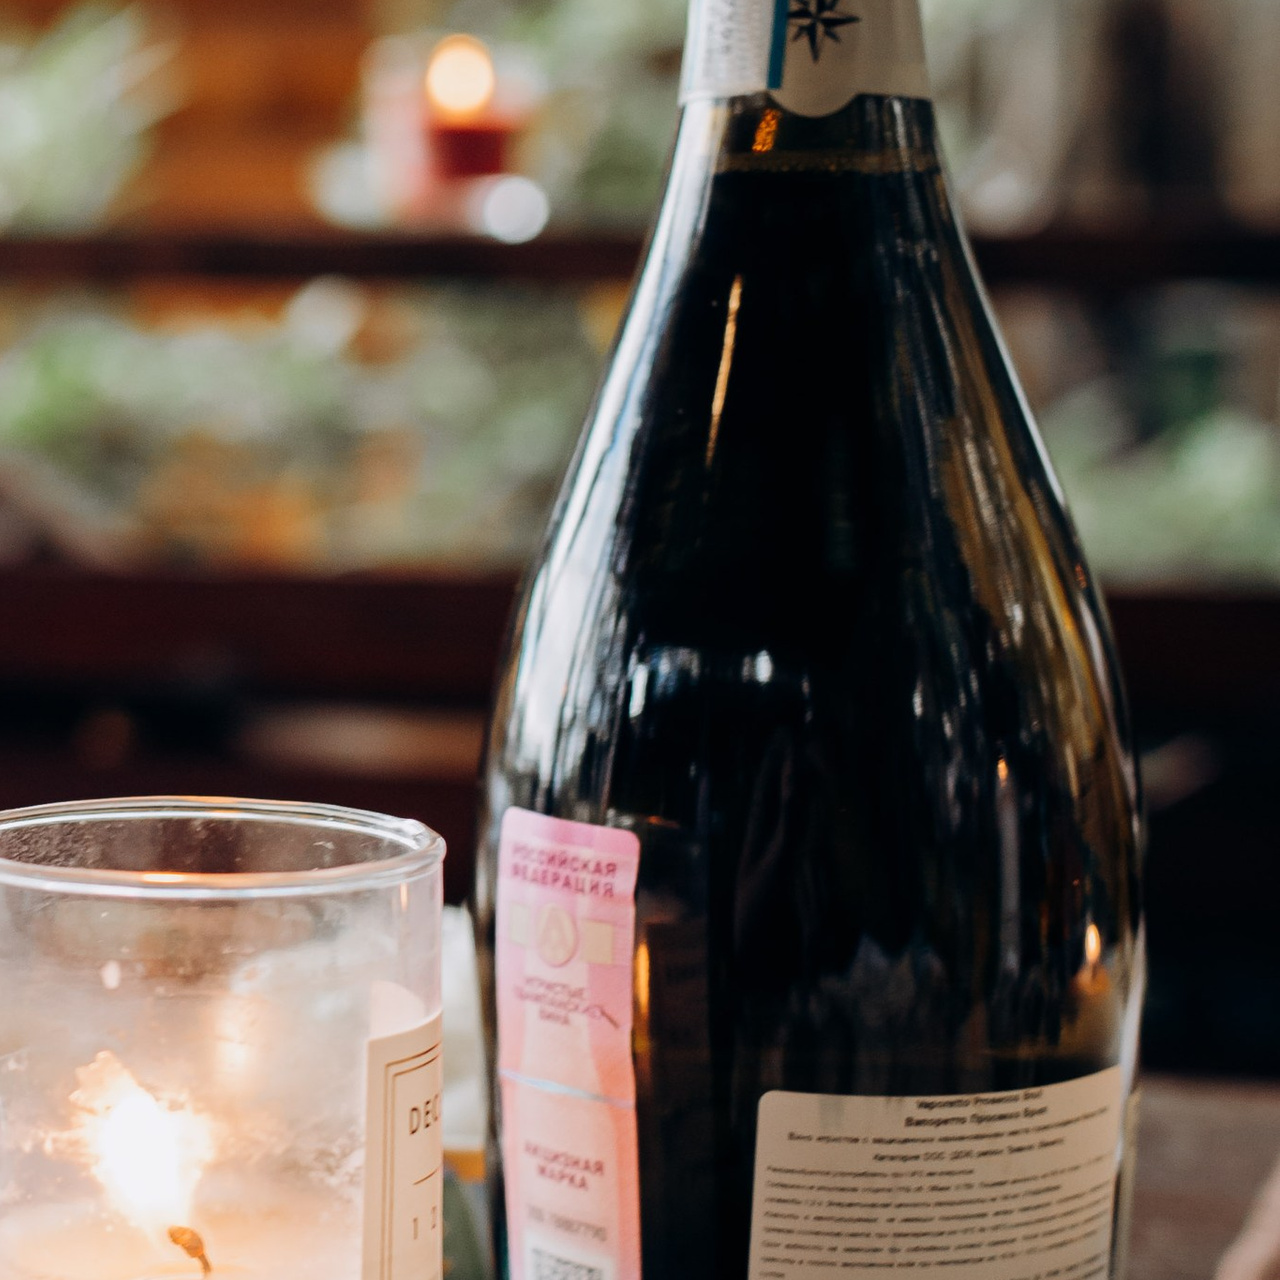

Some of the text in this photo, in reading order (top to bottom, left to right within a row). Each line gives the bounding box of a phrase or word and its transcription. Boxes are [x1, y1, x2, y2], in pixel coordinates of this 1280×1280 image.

[511, 842, 618, 877] РОССИЙСКАЯ
[511, 862, 615, 898] ФЕДЕРАЦИЯ
[412, 1217, 418, 1240] 1
